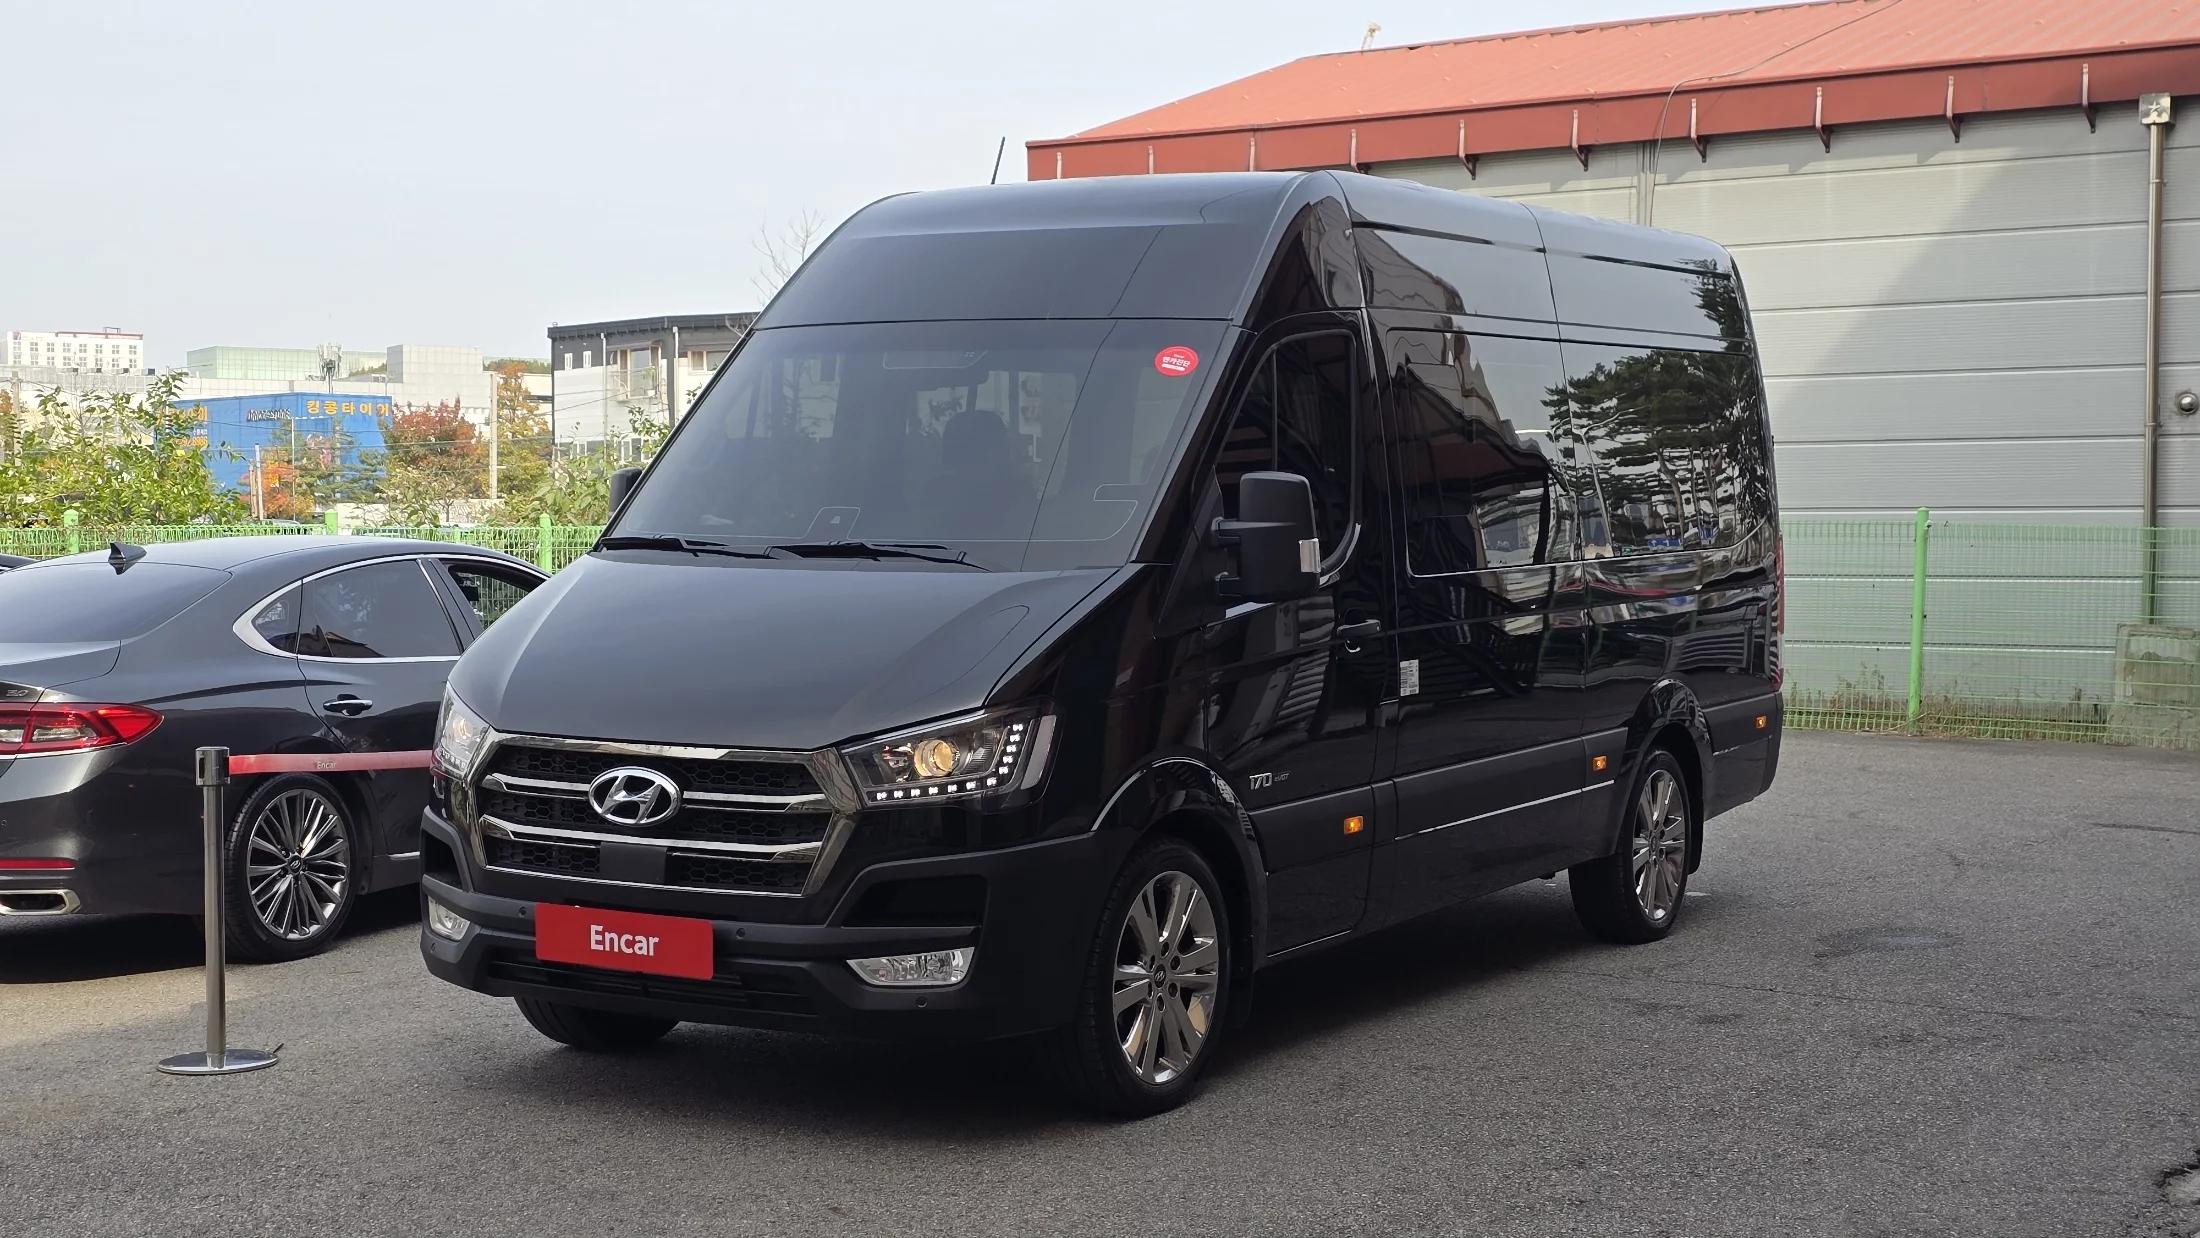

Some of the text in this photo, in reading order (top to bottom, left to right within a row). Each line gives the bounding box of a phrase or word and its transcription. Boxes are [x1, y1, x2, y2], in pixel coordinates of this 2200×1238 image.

[306, 400, 390, 417] 킹콩타이어
[317, 760, 337, 769] Encar
[1249, 772, 1272, 790] 170
[590, 924, 660, 957] Encar
